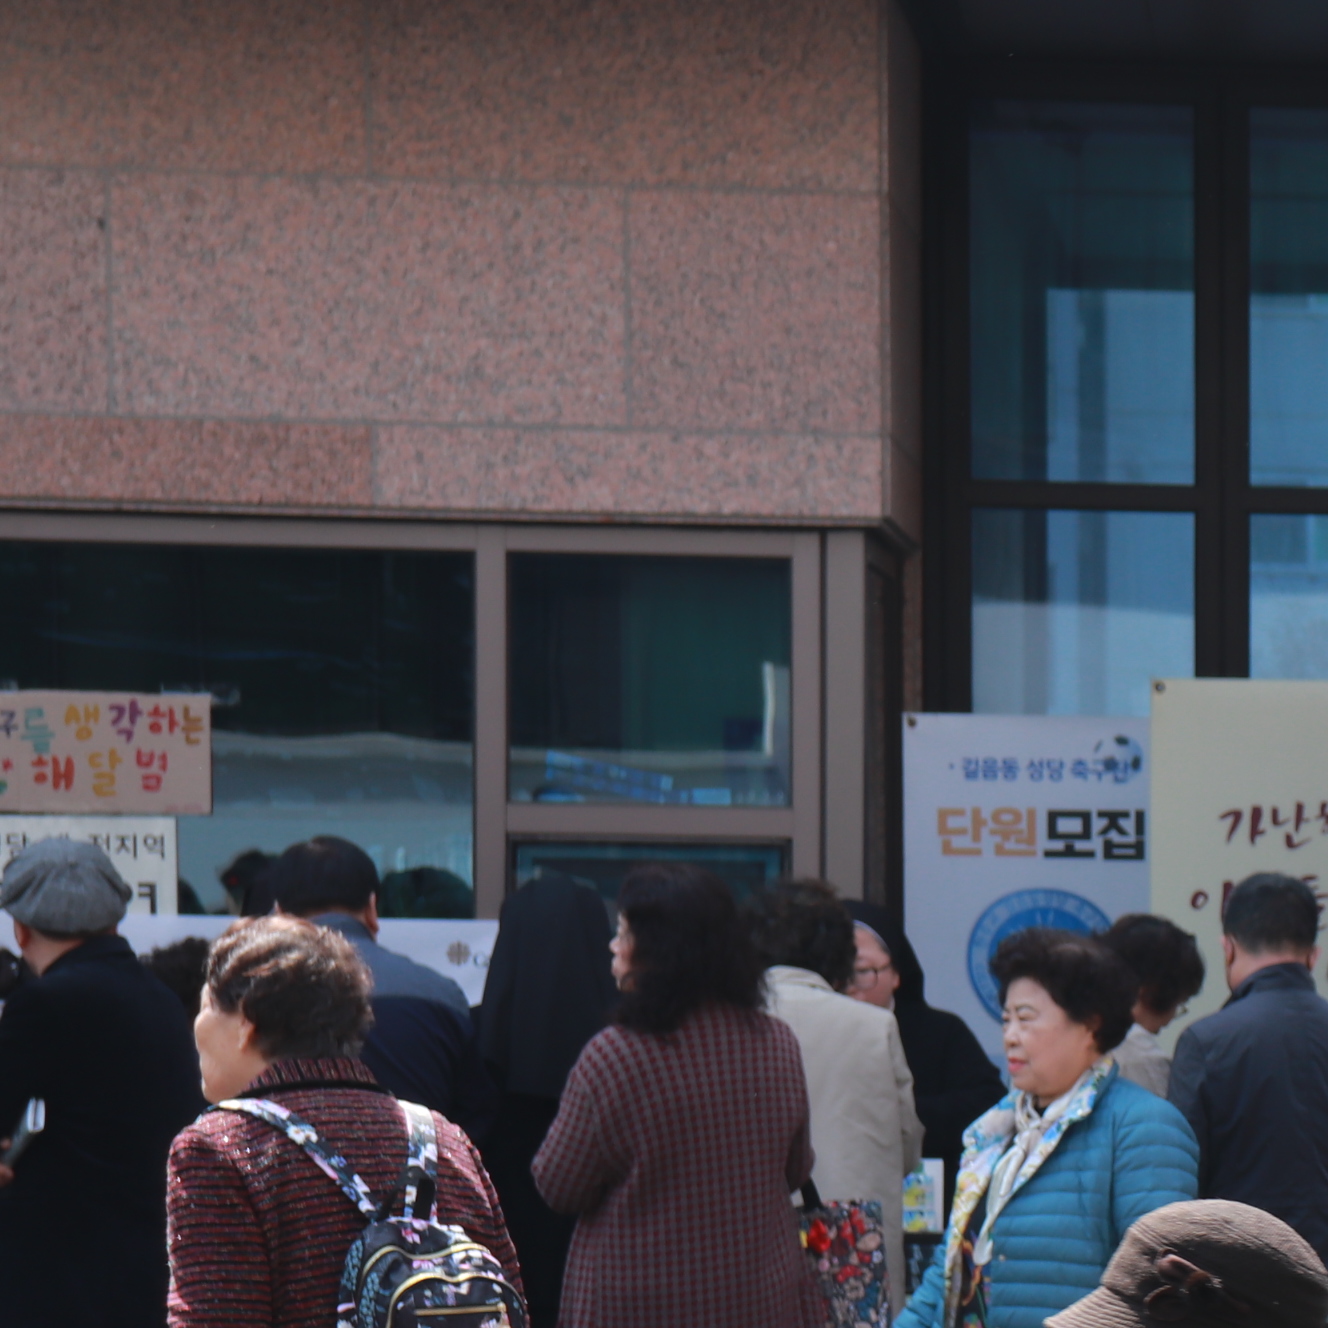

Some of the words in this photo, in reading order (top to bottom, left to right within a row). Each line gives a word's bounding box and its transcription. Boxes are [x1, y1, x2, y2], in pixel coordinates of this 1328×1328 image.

[1026, 757, 1064, 783] 성당
[937, 806, 1038, 856] 단원
[1043, 809, 1146, 860] 모집
